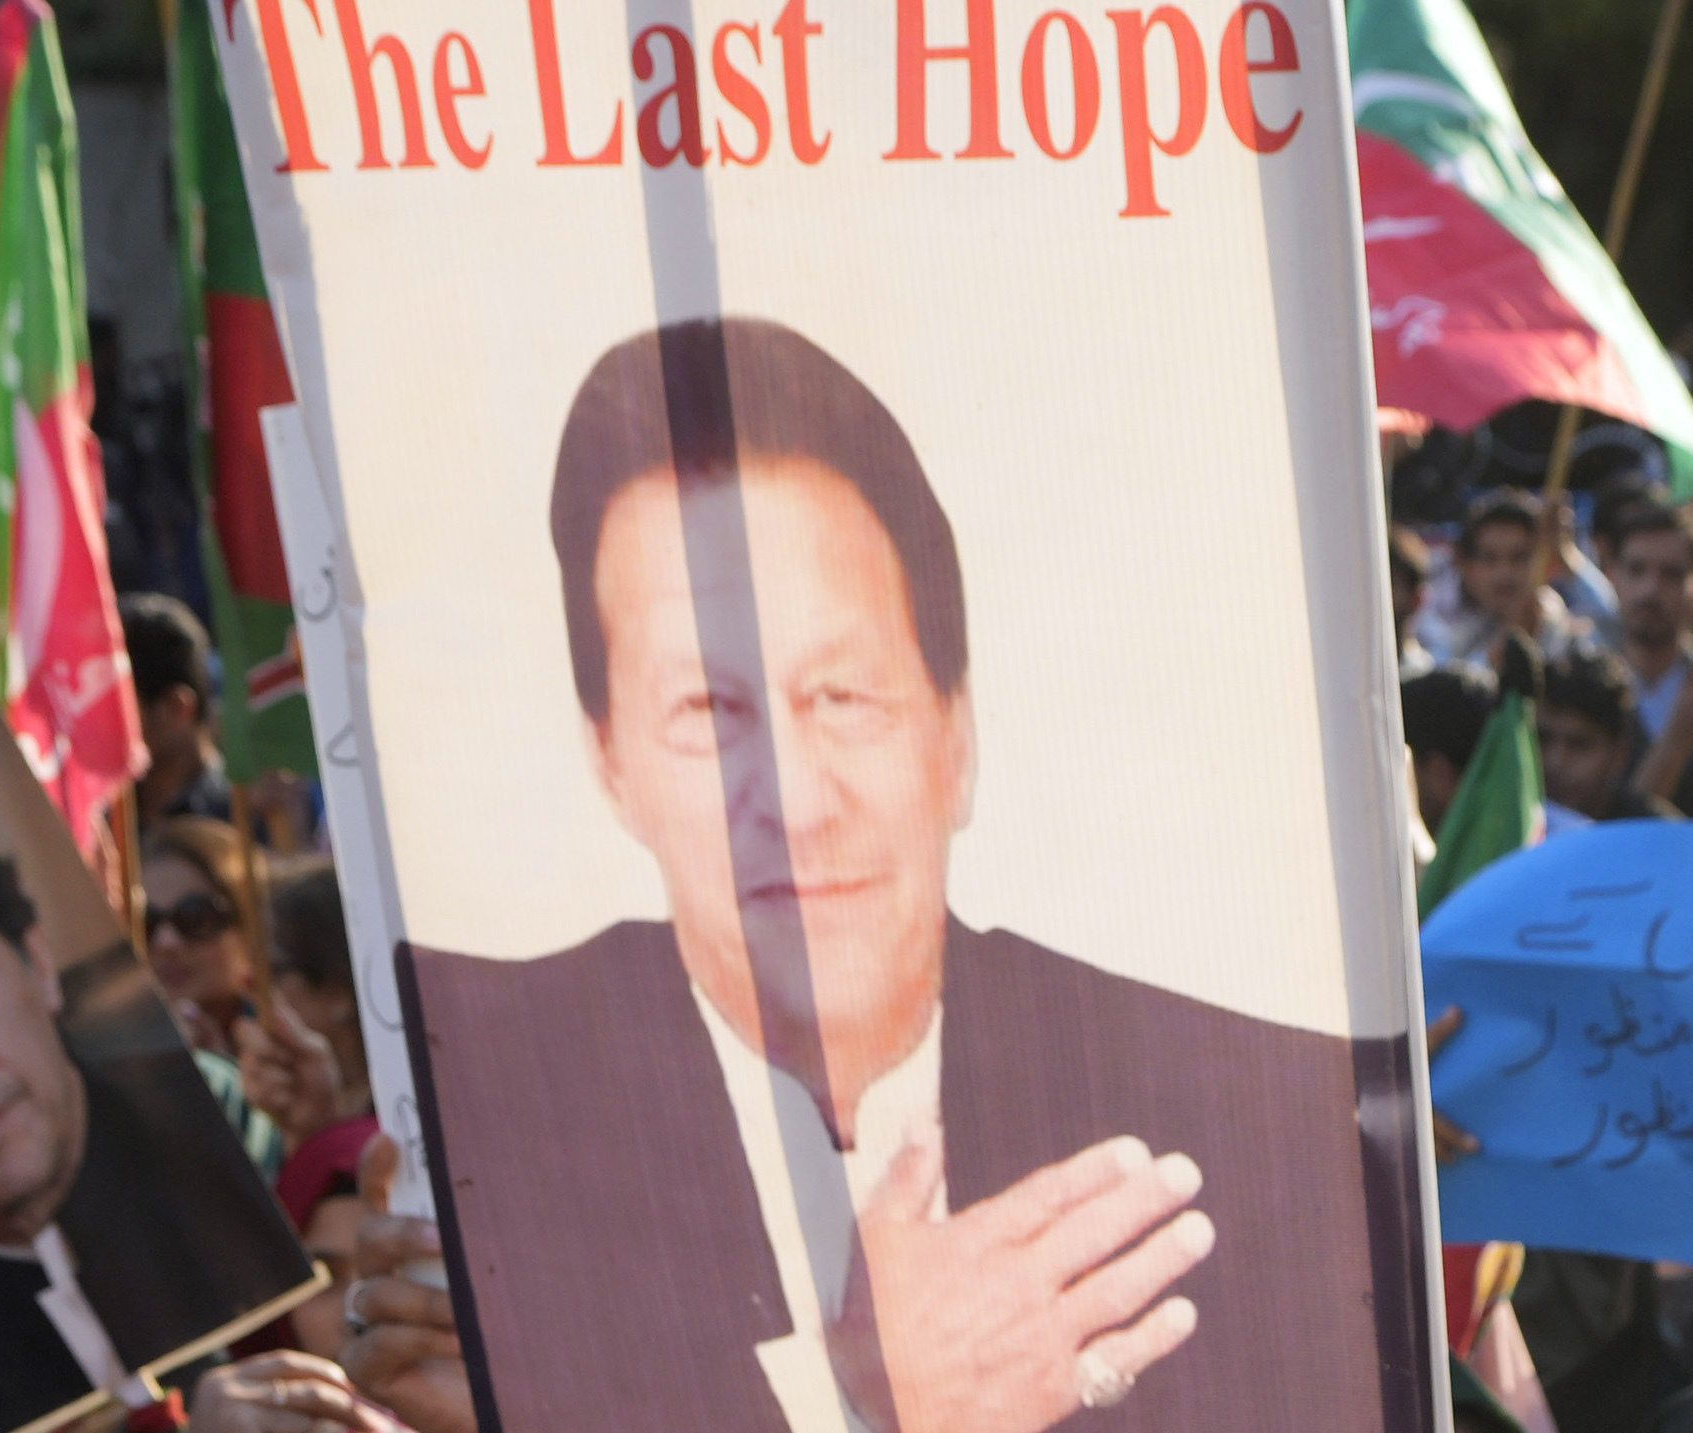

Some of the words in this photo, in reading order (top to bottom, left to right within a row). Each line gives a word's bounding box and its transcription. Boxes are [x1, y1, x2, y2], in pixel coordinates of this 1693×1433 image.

[224, 0, 495, 173] The
[533, 0, 833, 168] Last
[881, 0, 1306, 218] Hope
